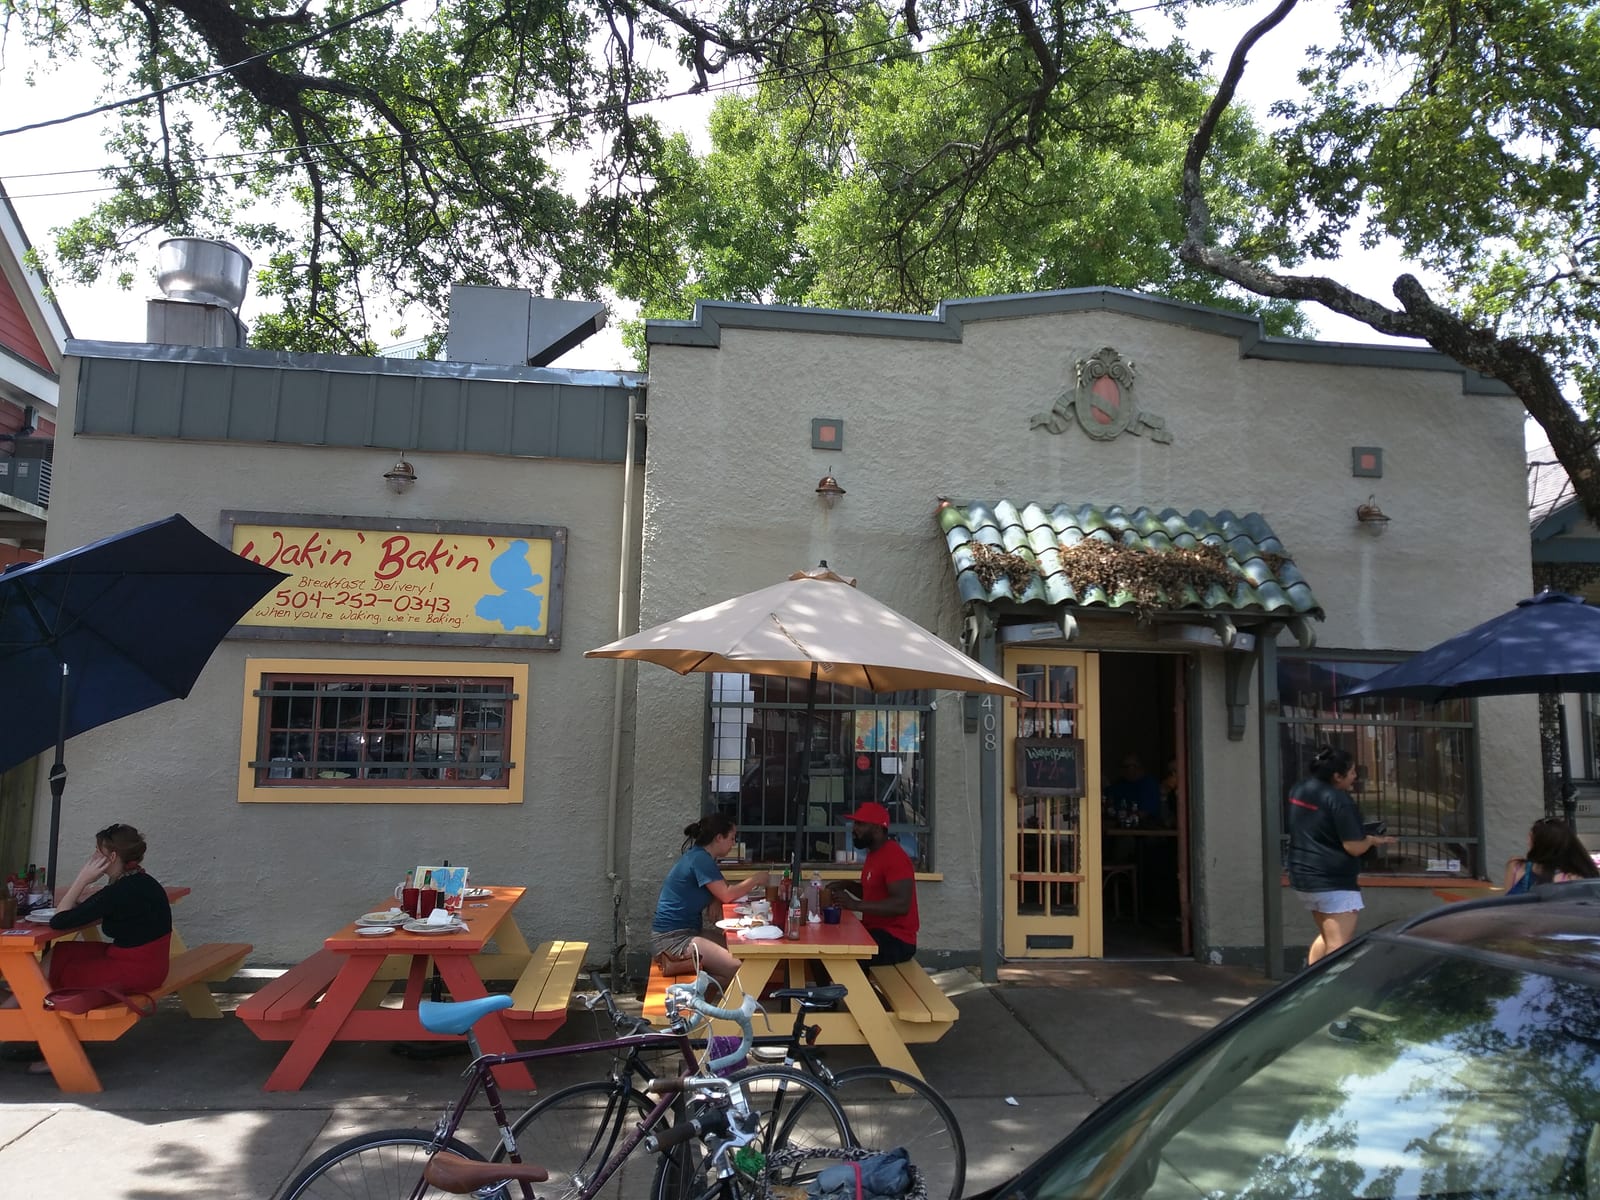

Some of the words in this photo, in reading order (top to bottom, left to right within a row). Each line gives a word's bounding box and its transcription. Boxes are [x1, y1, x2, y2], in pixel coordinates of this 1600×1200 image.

[374, 535, 496, 580] Bakin'
[298, 576, 366, 590] Breakfast
[371, 578, 434, 596] Delivery!
[275, 589, 450, 614] 504-252-0343
[294, 608, 333, 621] you're
[387, 613, 420, 624] we're
[981, 695, 996, 751] 408
